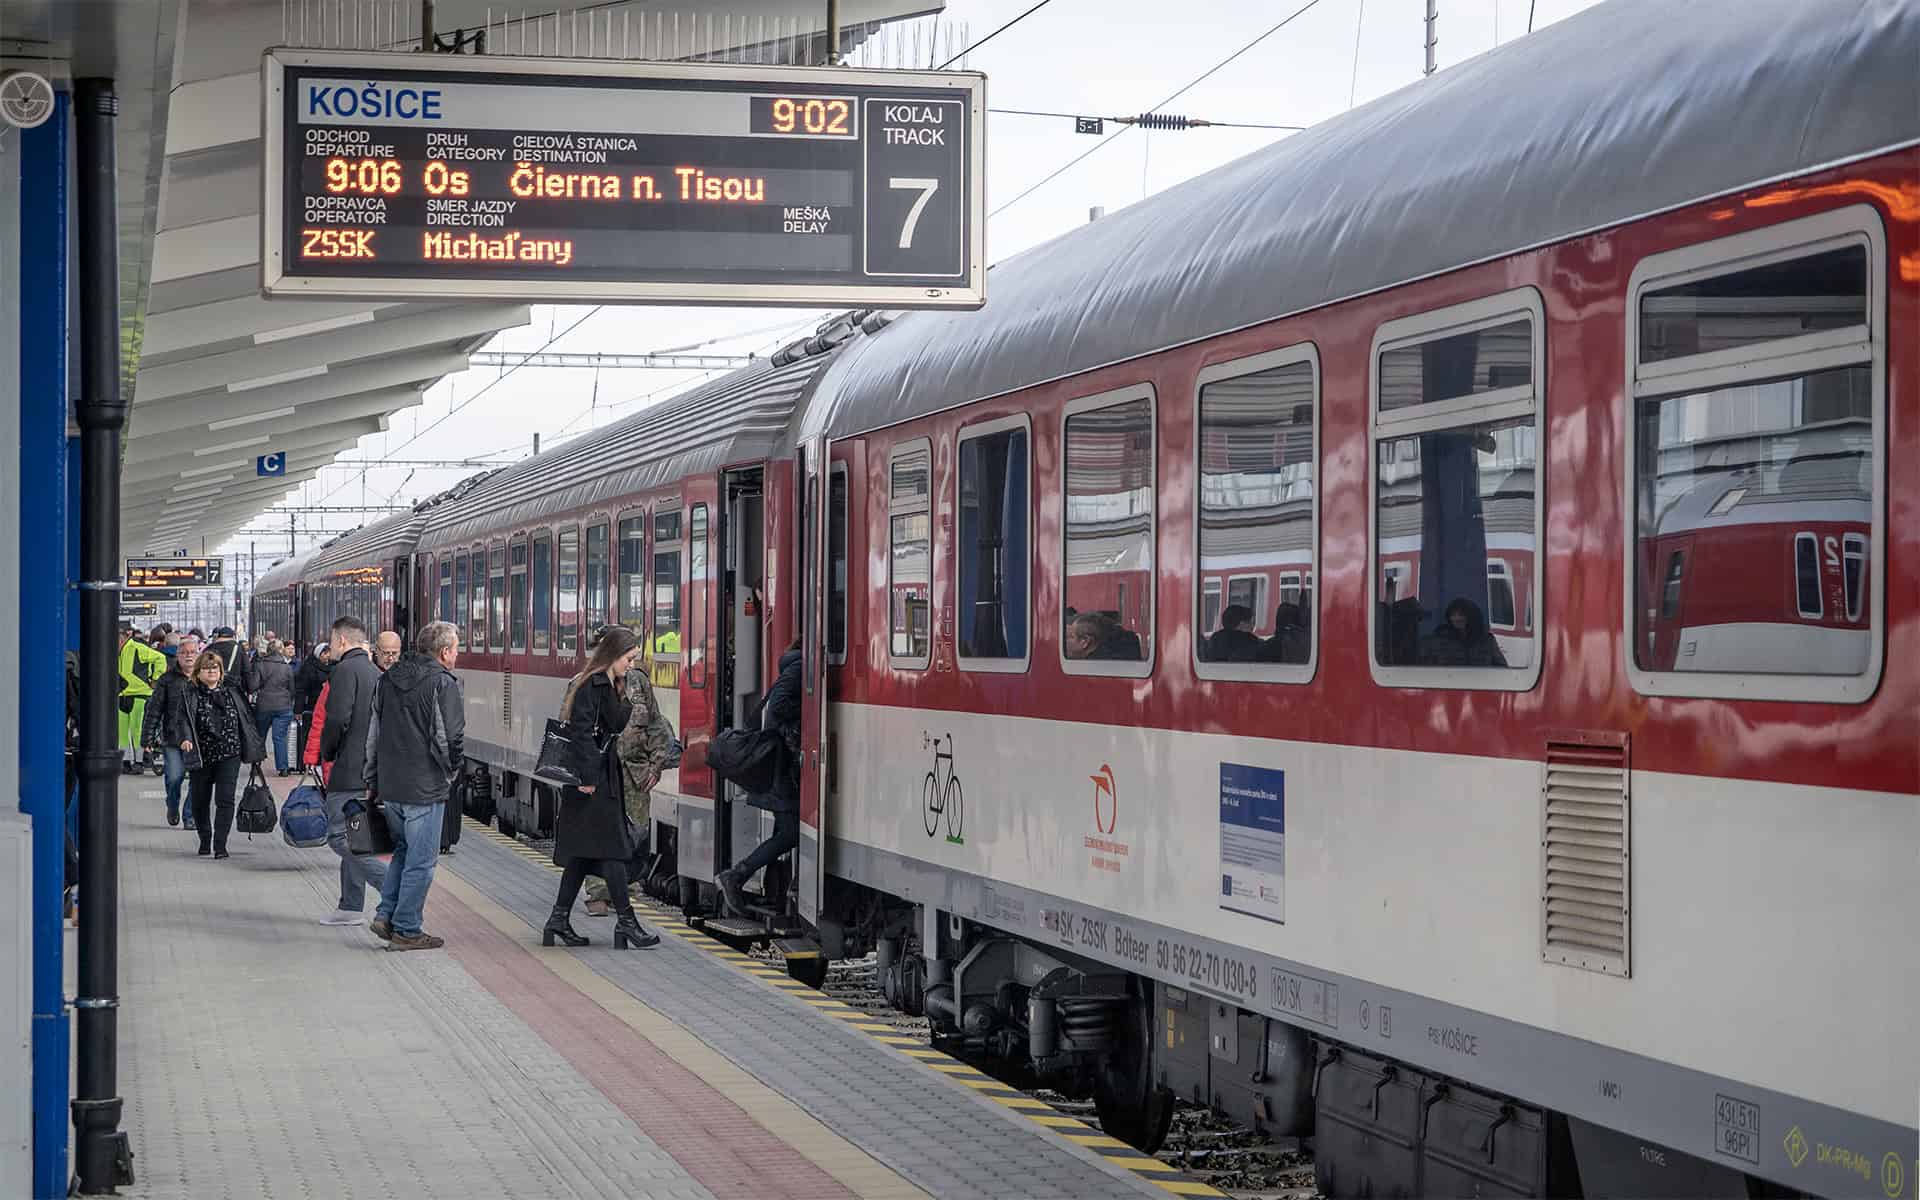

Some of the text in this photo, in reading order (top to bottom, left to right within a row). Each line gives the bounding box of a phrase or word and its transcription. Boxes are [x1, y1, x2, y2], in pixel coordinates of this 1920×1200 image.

[309, 82, 442, 120] KOŠICE
[772, 98, 849, 134] 9:02
[885, 105, 943, 123] KOĽAJ
[305, 130, 370, 144] ODCHOD
[427, 133, 468, 147] DRUH
[513, 134, 638, 152] CIEĽOVÁ STANICA
[883, 128, 944, 146] TRACK
[305, 144, 395, 159] DEPARTURE
[426, 147, 506, 161] CATEGORY
[513, 150, 607, 164] DESTINATION
[326, 159, 765, 201] 9:06 Os Čierna n. Tisou
[305, 197, 387, 211] DOPRAVCA
[427, 200, 516, 215] SMER JAZDY
[305, 210, 387, 225] OPERATOR
[427, 213, 505, 227] DIRECTION
[784, 206, 831, 221] MEŠKÁ
[889, 177, 939, 249] 7
[784, 221, 828, 234] DELAY
[303, 230, 376, 258] ZSSK
[423, 232, 573, 265] Michaľany
[263, 455, 280, 472] C
[209, 570, 219, 582] 7
[1115, 927, 1150, 966] Bdteer
[1157, 938, 1169, 971] 50
[1173, 943, 1186, 976] 56
